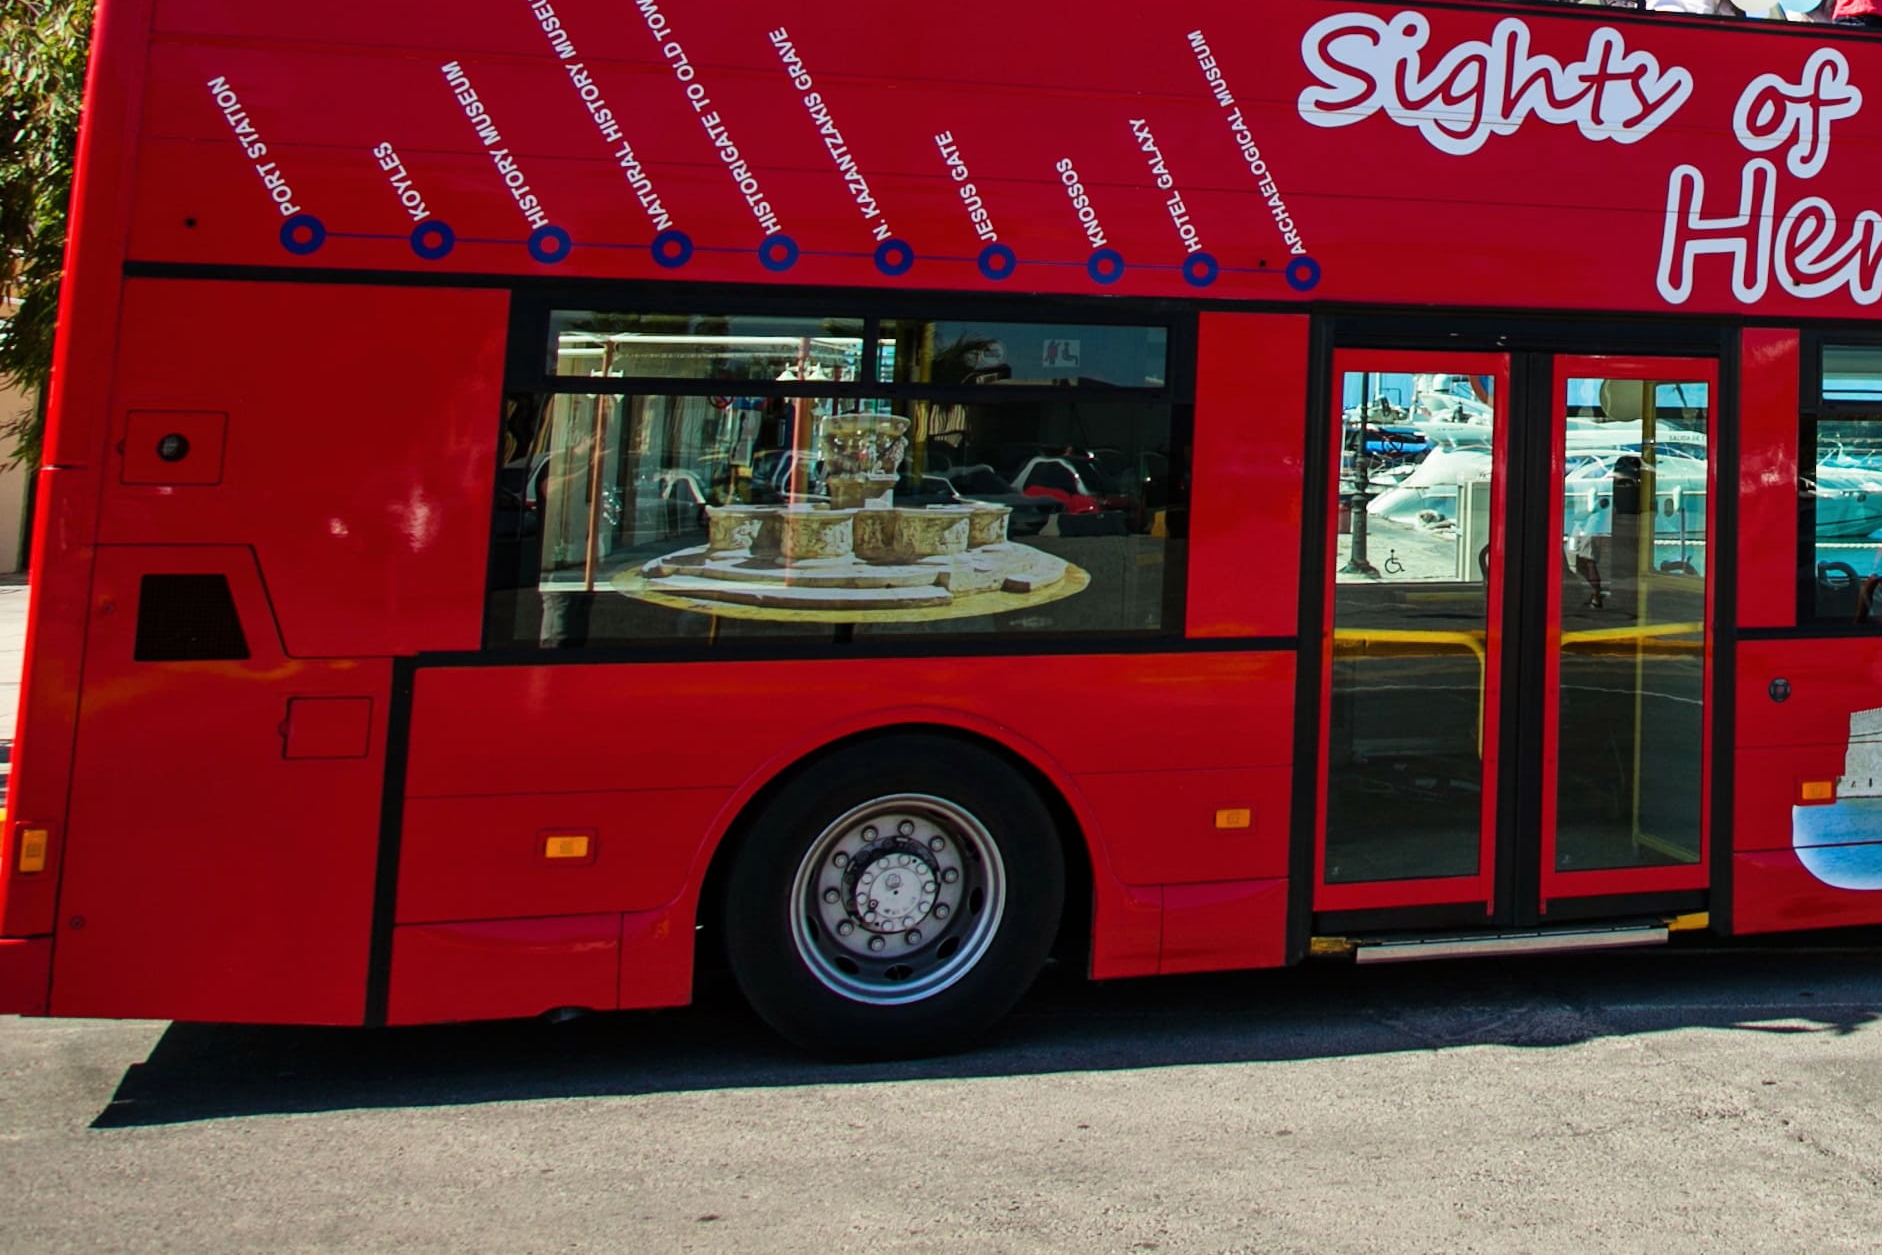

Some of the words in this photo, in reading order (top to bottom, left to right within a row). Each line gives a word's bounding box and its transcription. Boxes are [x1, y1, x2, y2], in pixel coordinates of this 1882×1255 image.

[663, 41, 695, 82] OLD
[686, 83, 711, 113] TO
[768, 26, 813, 91] GRAVE
[1187, 30, 1235, 107] MUSEUM
[1298, 11, 1694, 156] Sights
[1732, 47, 1863, 179] of
[207, 76, 267, 159] STATION
[441, 60, 501, 146] MUSEUM
[565, 63, 623, 143] HISTORY
[255, 162, 301, 216] PORT
[373, 141, 431, 222] KOYLES
[489, 148, 549, 230] HISTORY
[615, 141, 673, 231] NATURAL
[701, 111, 782, 235] HISTORIGATE
[803, 92, 881, 219] KAZANTZAKIS
[934, 130, 969, 182] GATE
[1129, 118, 1173, 190] GALAXY
[1227, 106, 1307, 255] ARCHAELOGICAL
[872, 218, 892, 241] N.
[959, 183, 998, 243] JESUS
[1055, 157, 1108, 248] KNOSSOS
[1166, 190, 1202, 253] HOTEL
